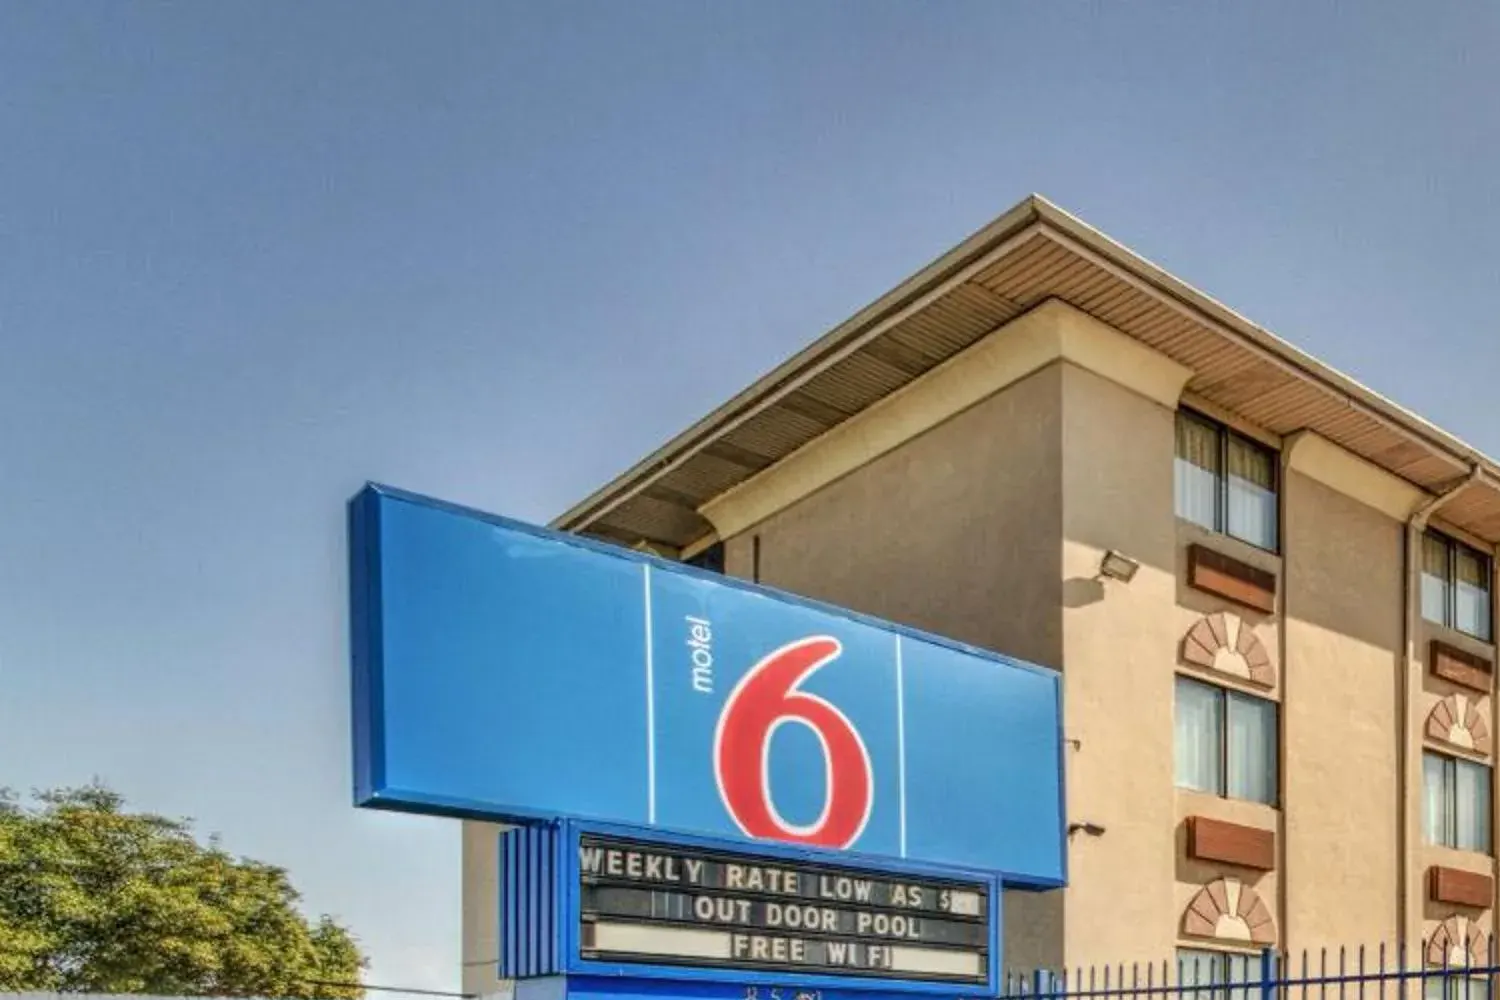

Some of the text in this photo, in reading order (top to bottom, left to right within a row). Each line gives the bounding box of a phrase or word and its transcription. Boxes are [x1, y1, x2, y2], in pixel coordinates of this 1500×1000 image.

[685, 615, 713, 692] motel
[713, 634, 874, 850] 6
[580, 847, 702, 883] WEEKLY
[725, 863, 797, 893] RATE
[820, 876, 871, 902] LOW
[892, 884, 922, 907] AS
[695, 896, 920, 937] OUT DOOR POOL
[734, 934, 804, 961] FREE
